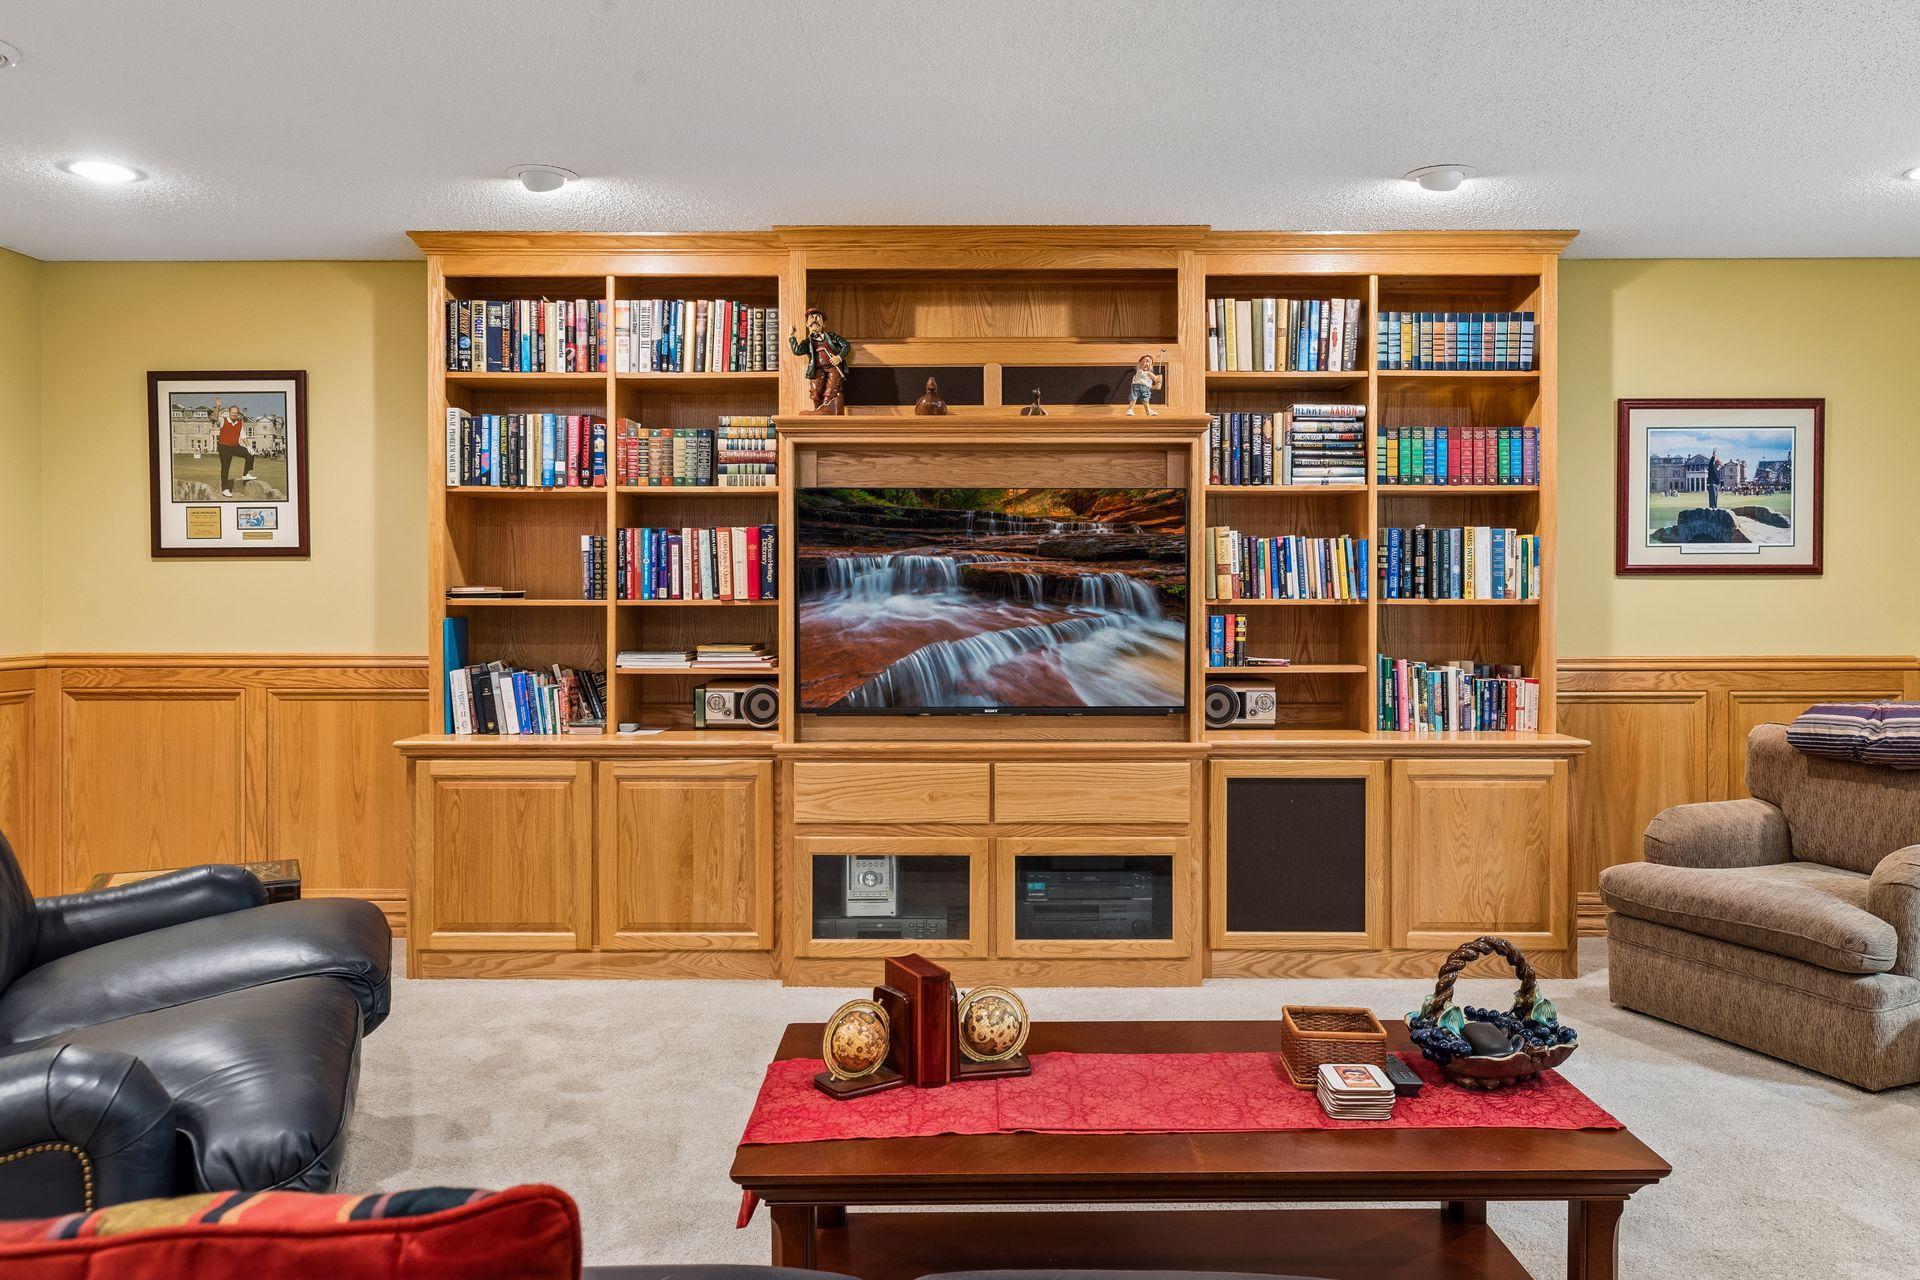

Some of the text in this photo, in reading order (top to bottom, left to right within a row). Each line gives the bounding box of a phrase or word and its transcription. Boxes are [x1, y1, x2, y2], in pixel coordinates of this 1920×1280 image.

[474, 304, 484, 316] KEN
[474, 316, 484, 338] FOLLETT
[1330, 407, 1357, 415] AARON
[1253, 415, 1261, 455] JOHN GRISHAM
